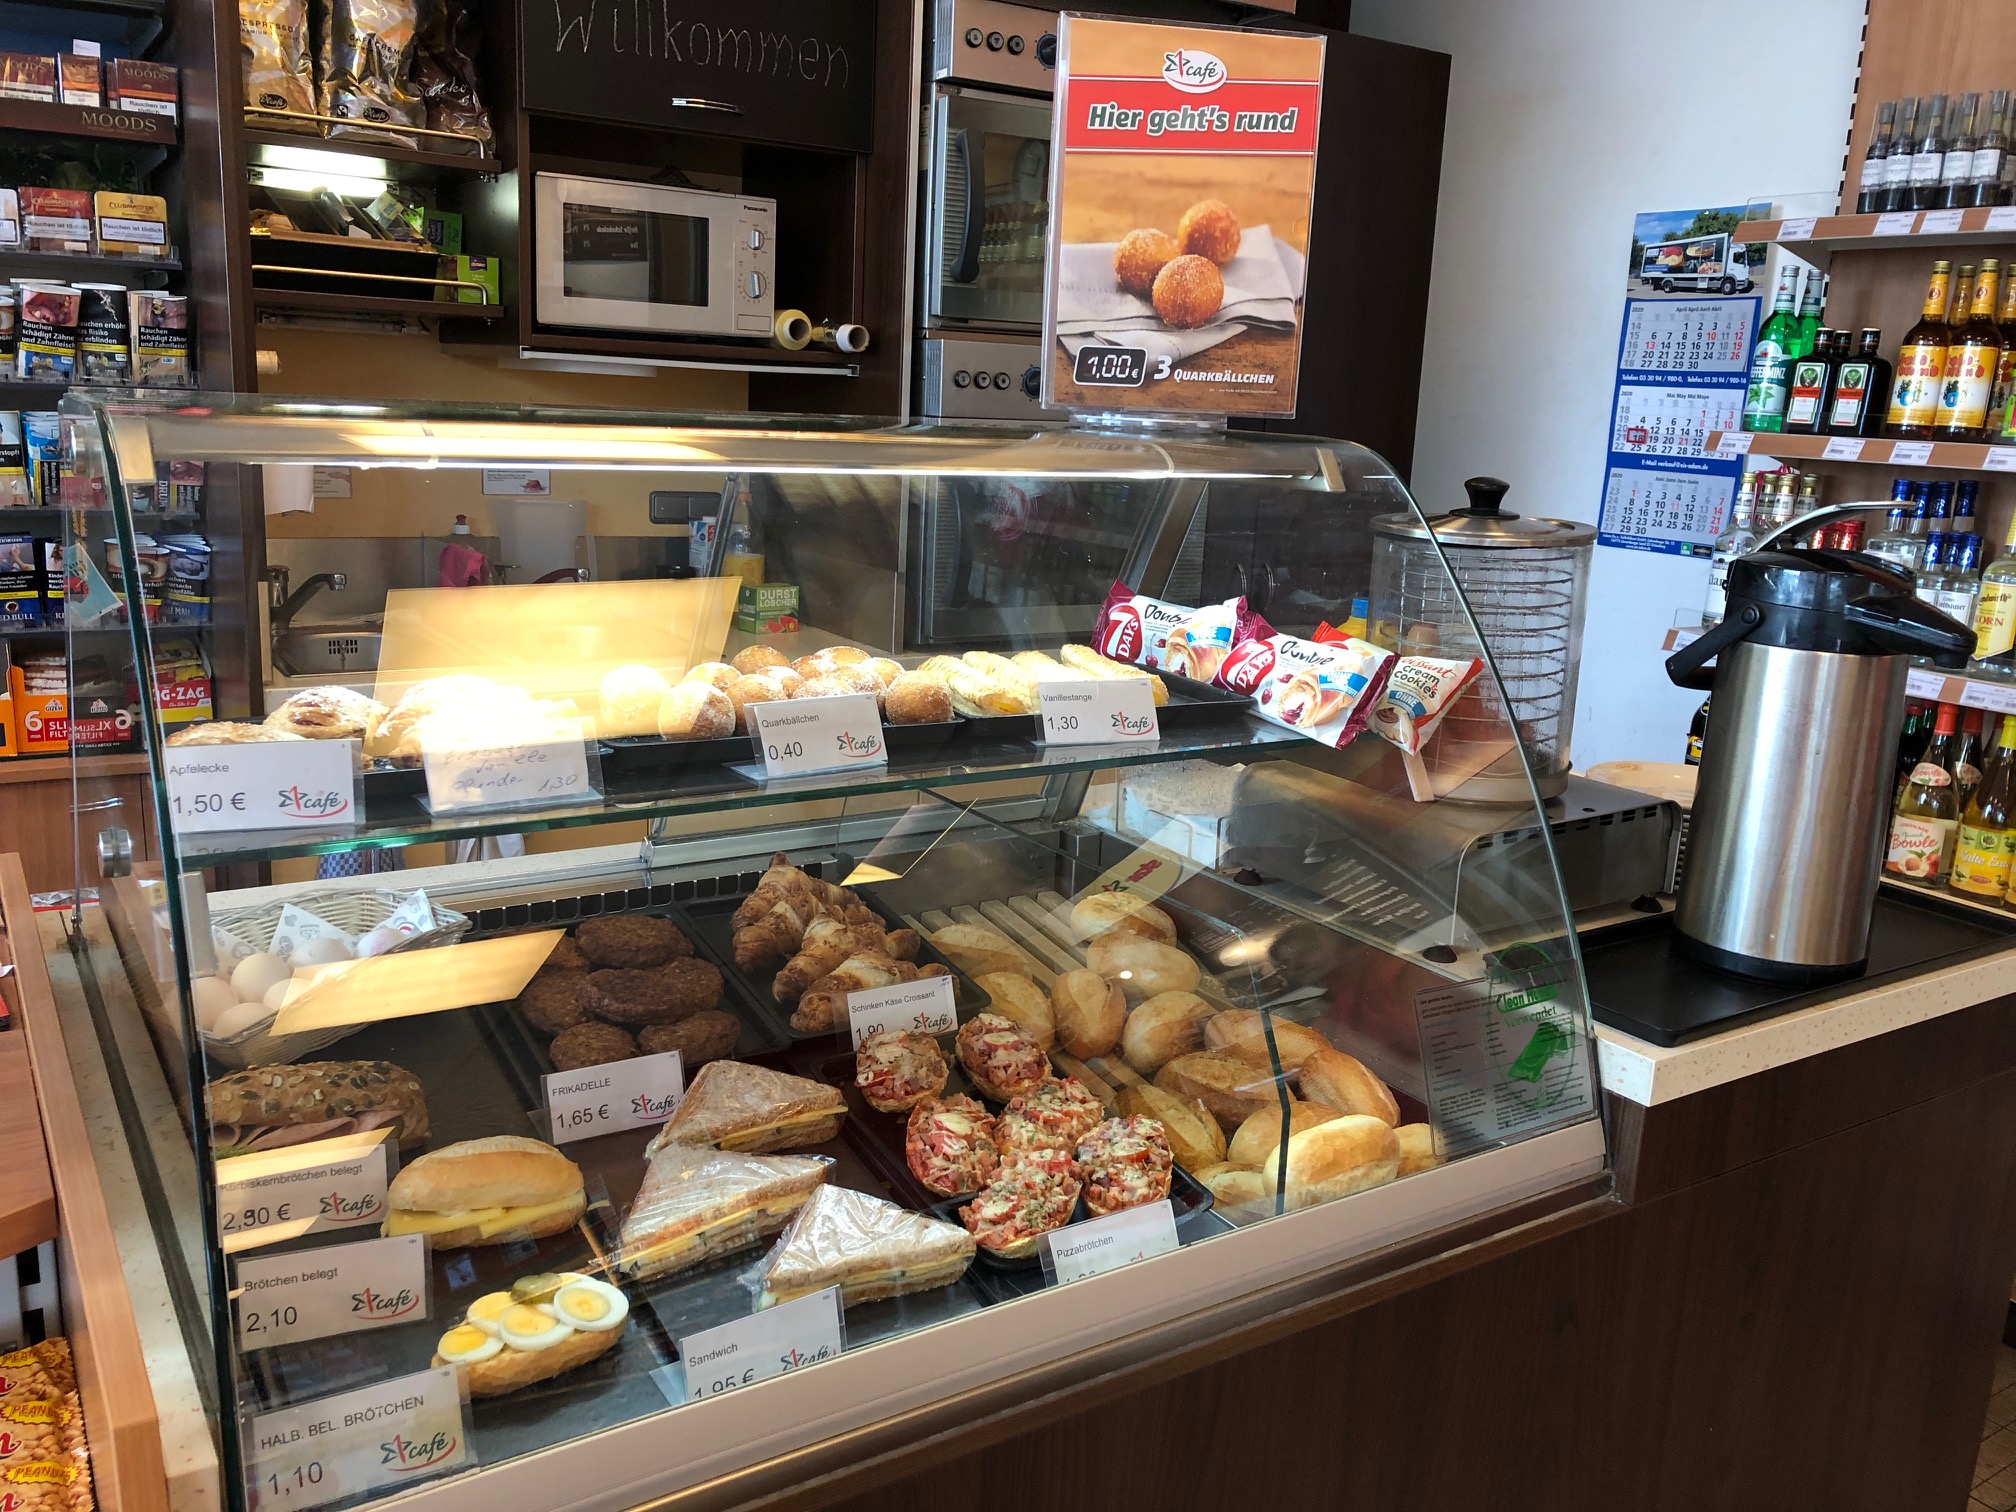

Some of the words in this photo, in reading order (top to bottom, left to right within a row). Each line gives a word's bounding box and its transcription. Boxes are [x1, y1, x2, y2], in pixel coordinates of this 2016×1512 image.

[556, 0, 848, 87] Willkommen
[124, 68, 169, 80] MOODS
[129, 100, 158, 109] Rauchen
[82, 111, 157, 132] MOODS
[1088, 101, 1143, 130] Hier
[1147, 105, 1228, 136] geht's
[1234, 107, 1298, 132] rund
[744, 205, 768, 213] Panasonic
[22, 329, 52, 339] schädigt
[53, 333, 74, 342] Zähne
[23, 321, 53, 331] Rauchen
[36, 338, 76, 348] Zahnfleisch
[85, 336, 117, 344] erblinden
[141, 333, 168, 342] schädigt
[1154, 355, 1172, 380] 3
[1174, 368, 1274, 384] QUARKBÄLLCHEN
[159, 480, 168, 508] DRUM
[760, 589, 796, 600] DURST
[1107, 612, 1129, 657] 7
[1118, 618, 1139, 658] DAYS
[1280, 640, 1335, 666] Double
[1237, 650, 1274, 689] DAYS
[1402, 666, 1440, 685] cream
[1394, 671, 1436, 698] cookies
[1042, 693, 1093, 703] Vanillestange
[1395, 692, 1421, 708] OHNE
[25, 711, 42, 731] 6
[761, 713, 820, 729] Quarkbällchen
[1046, 715, 1079, 731] 1,30
[768, 742, 803, 762] 0,40
[169, 763, 230, 776] Apfelecke
[538, 774, 578, 791] 1,30
[172, 792, 222, 817] 1,50
[230, 792, 246, 812] €
[1892, 834, 1938, 850] Bowle
[1960, 850, 1985, 865] Kalte
[852, 1002, 884, 1013] Schinken
[885, 997, 902, 1006] Käse
[904, 991, 935, 1003] Croissant
[552, 1078, 611, 1096] FRIKADELLE
[557, 1108, 593, 1129] 1,65
[598, 1104, 609, 1119] €
[220, 1169, 327, 1192] Kürbiskernbrötchen
[330, 1164, 363, 1177] belegt
[277, 1203, 291, 1221] €
[1057, 1235, 1113, 1259] Pizzabrötchen
[245, 1275, 298, 1292] Brötchen
[302, 1267, 338, 1283] belegt
[246, 1306, 297, 1334] 2,10
[689, 1343, 738, 1368] Sandwich
[742, 1368, 754, 1384] €
[261, 1430, 304, 1449] HALB.
[308, 1422, 340, 1437] BEL.
[344, 1395, 424, 1427] BRÖTCHEN
[268, 1461, 323, 1496] 1,10
